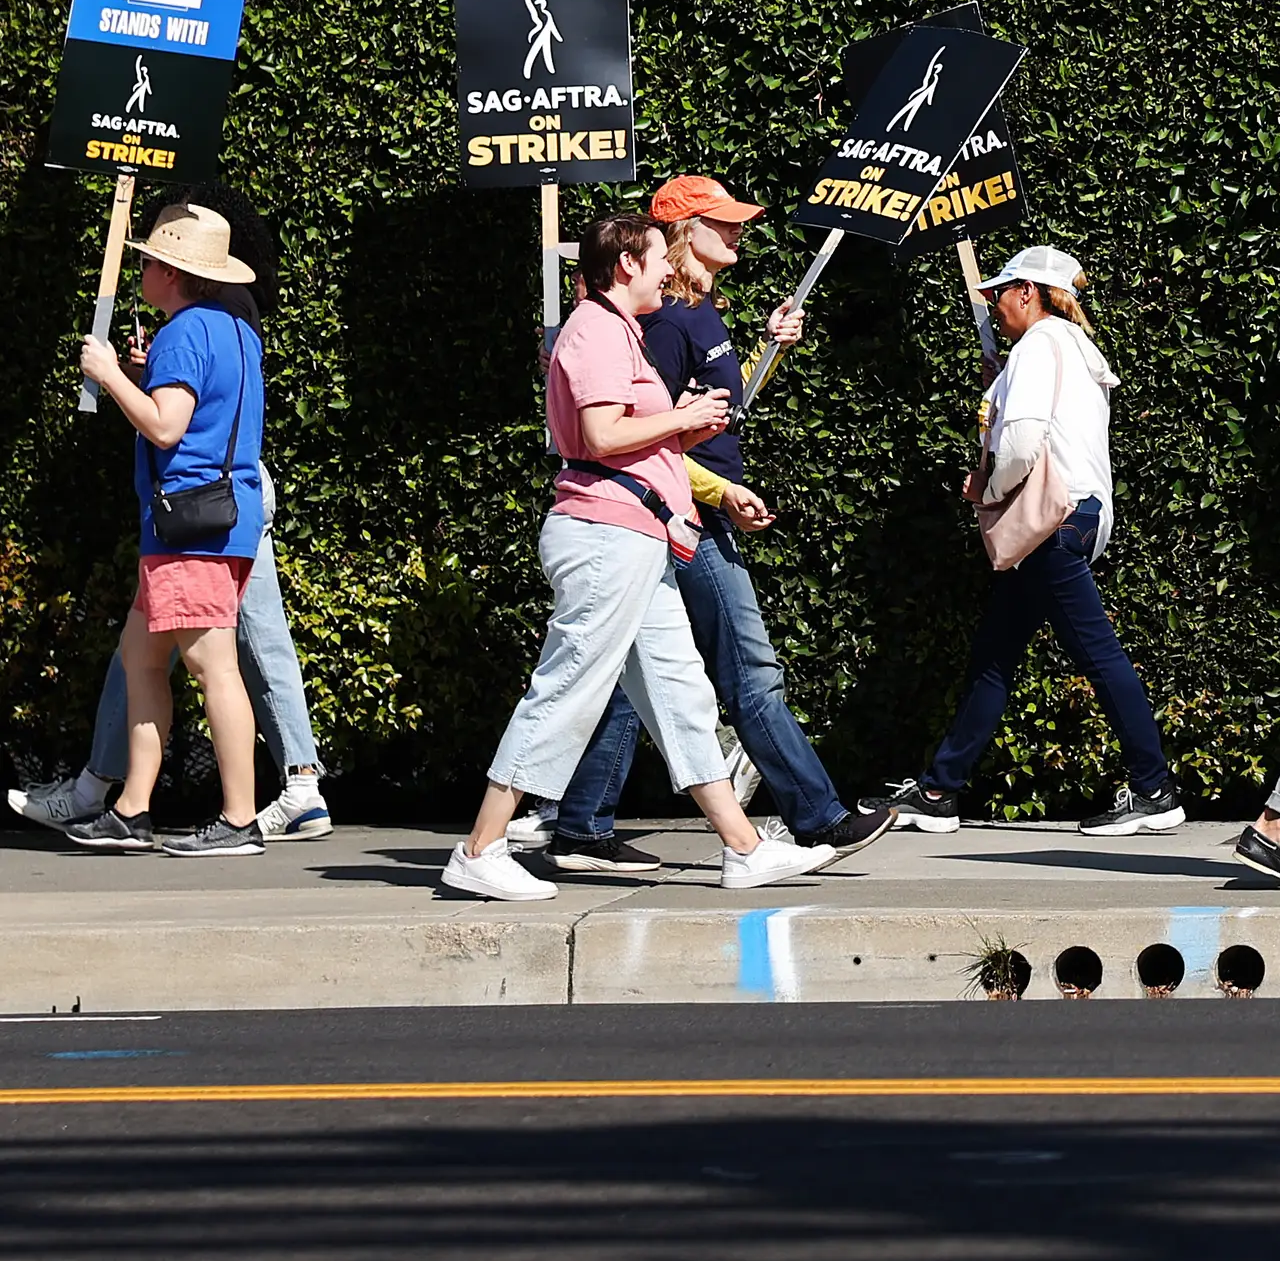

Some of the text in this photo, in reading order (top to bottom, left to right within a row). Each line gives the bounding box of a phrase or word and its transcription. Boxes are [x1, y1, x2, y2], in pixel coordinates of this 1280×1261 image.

[100, 8, 209, 46] STANDS WITH
[529, 114, 561, 131] ON
[86, 140, 176, 169] STRIKE!
[122, 133, 141, 146] ON
[467, 130, 627, 166] STRIKE!
[860, 165, 886, 182] ON
[807, 178, 923, 222] STRIKE!
[904, 170, 1017, 237] TRIKE!
